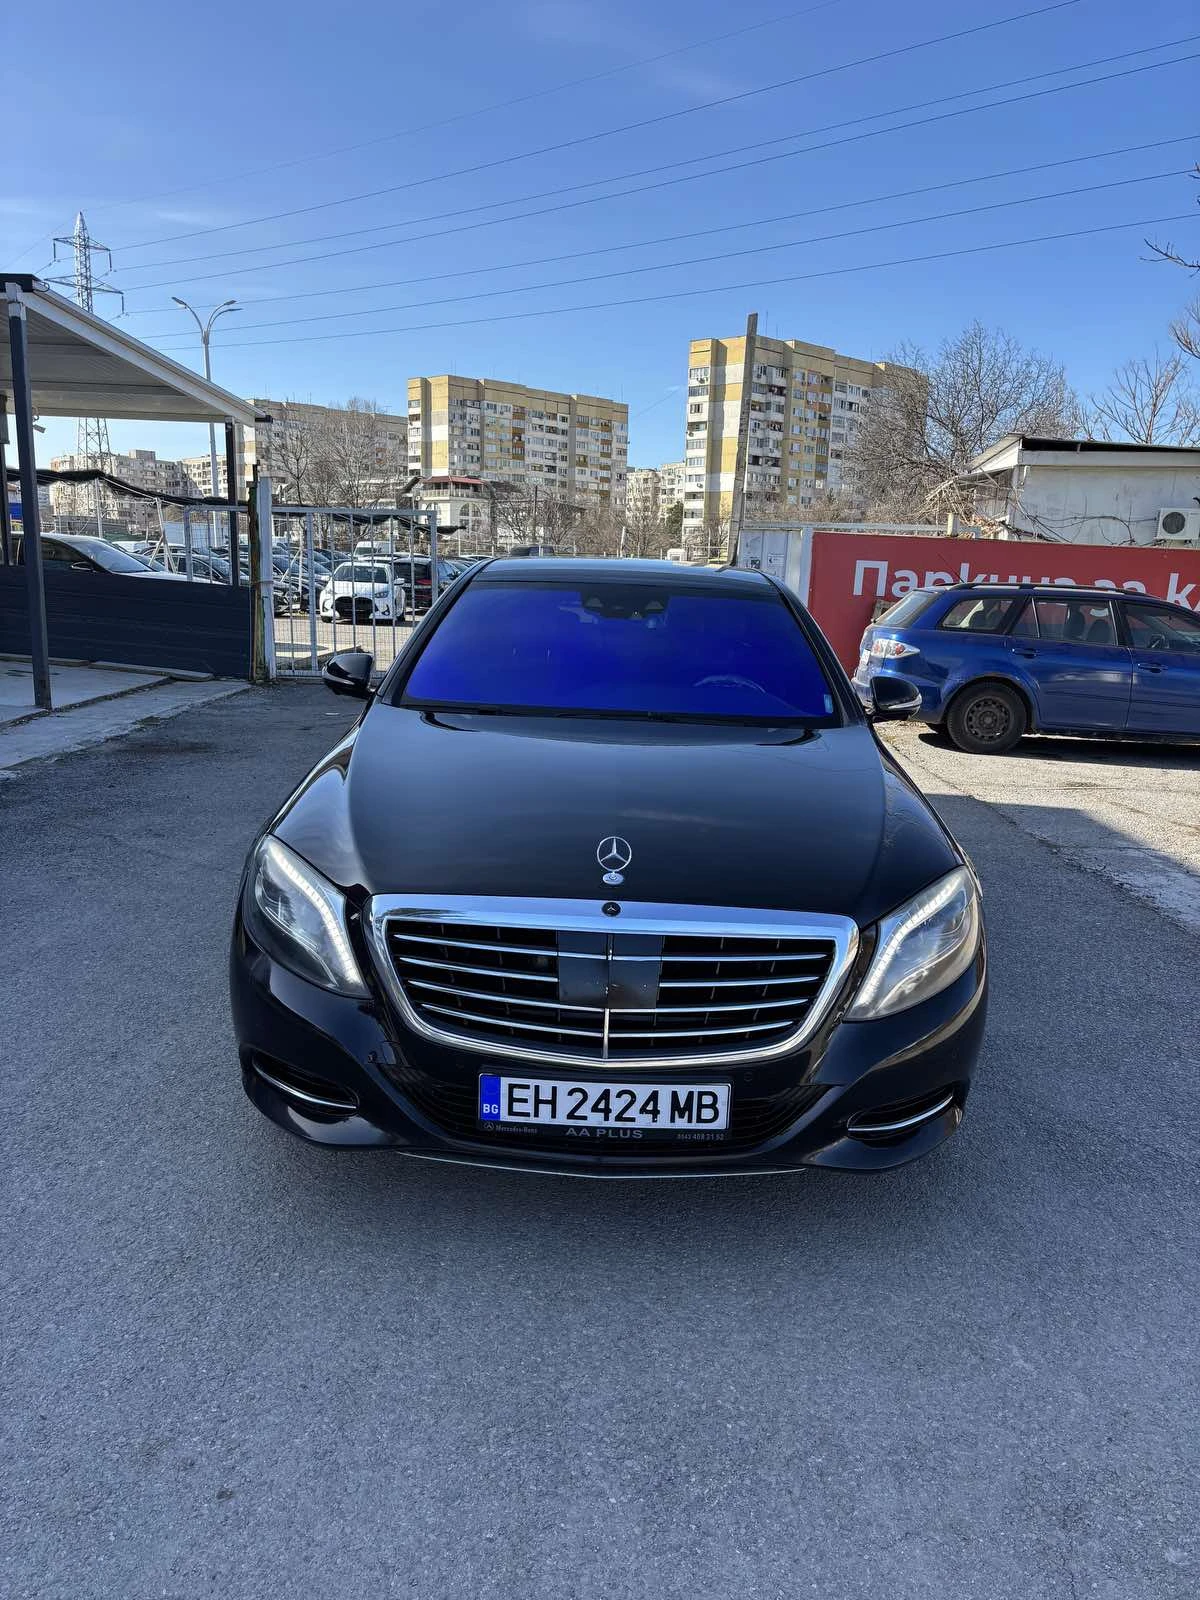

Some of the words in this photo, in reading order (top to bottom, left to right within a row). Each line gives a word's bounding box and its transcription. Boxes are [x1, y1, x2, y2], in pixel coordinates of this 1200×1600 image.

[483, 1103, 499, 1115] BG
[507, 1083, 558, 1119] EH
[566, 1087, 661, 1123] 2424
[669, 1090, 720, 1124] MB
[565, 1127, 591, 1137] AA
[596, 1128, 643, 1139] PLUS
